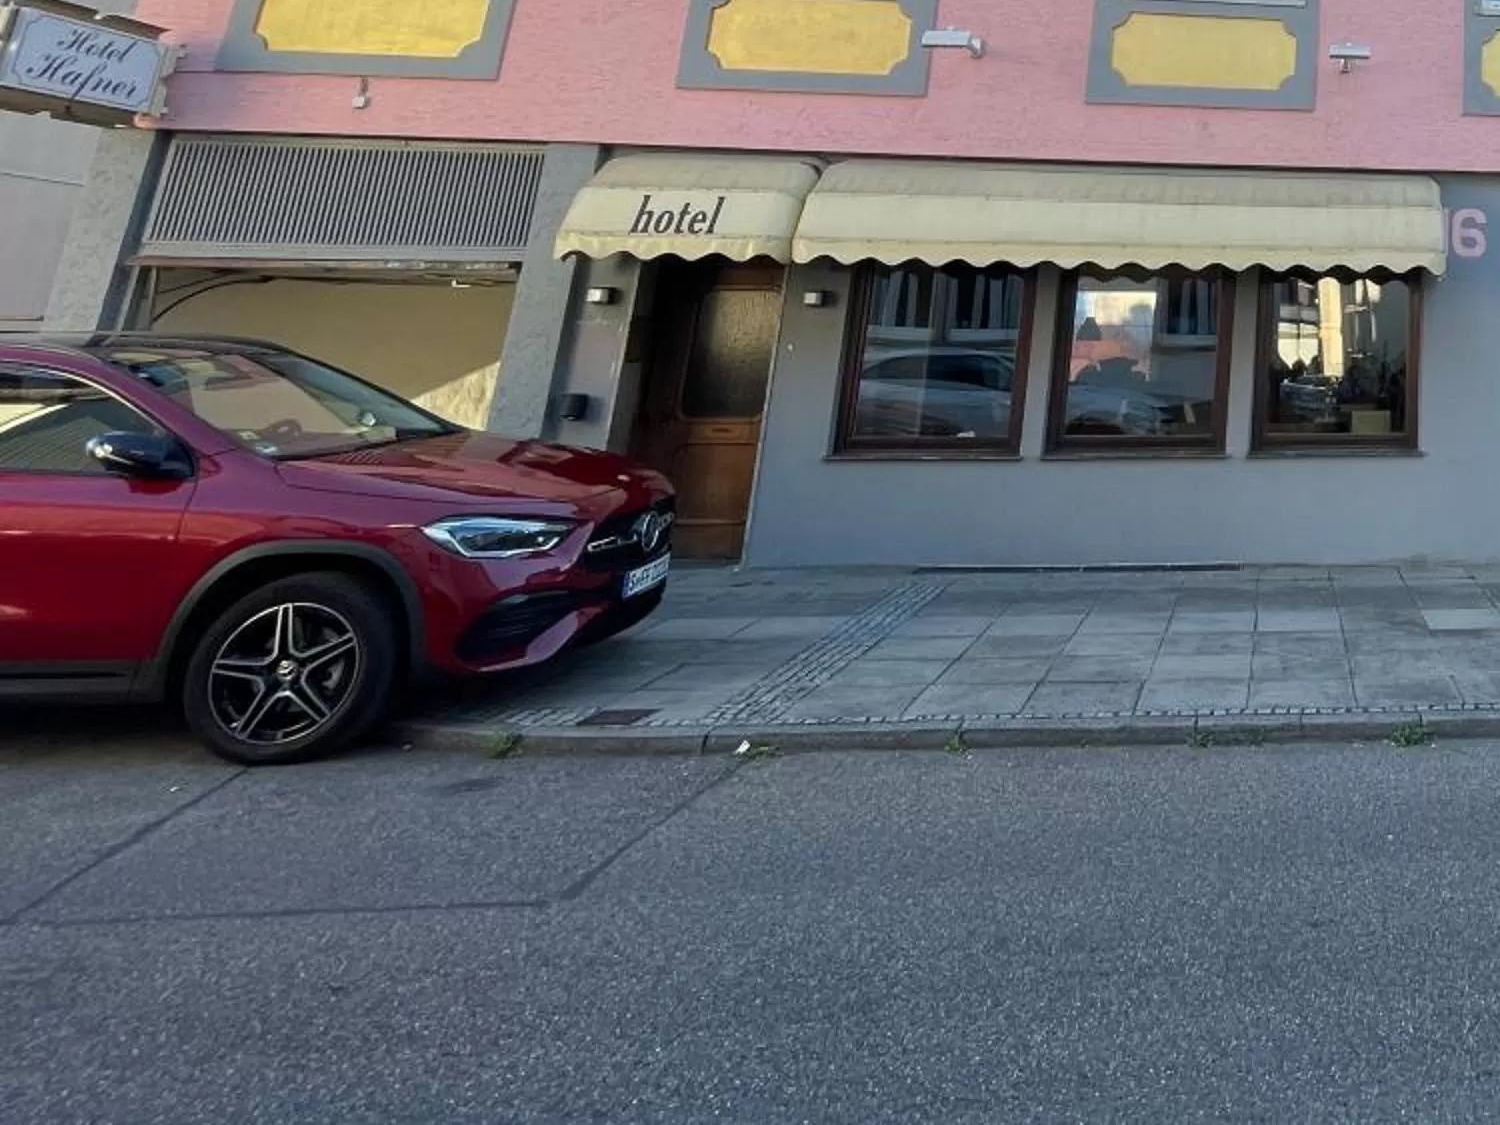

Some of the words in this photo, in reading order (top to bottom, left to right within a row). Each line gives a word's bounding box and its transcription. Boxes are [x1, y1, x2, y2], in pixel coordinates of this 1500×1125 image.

[57, 28, 138, 62] Hotel
[26, 54, 138, 99] Hafner
[628, 194, 726, 235] hotel
